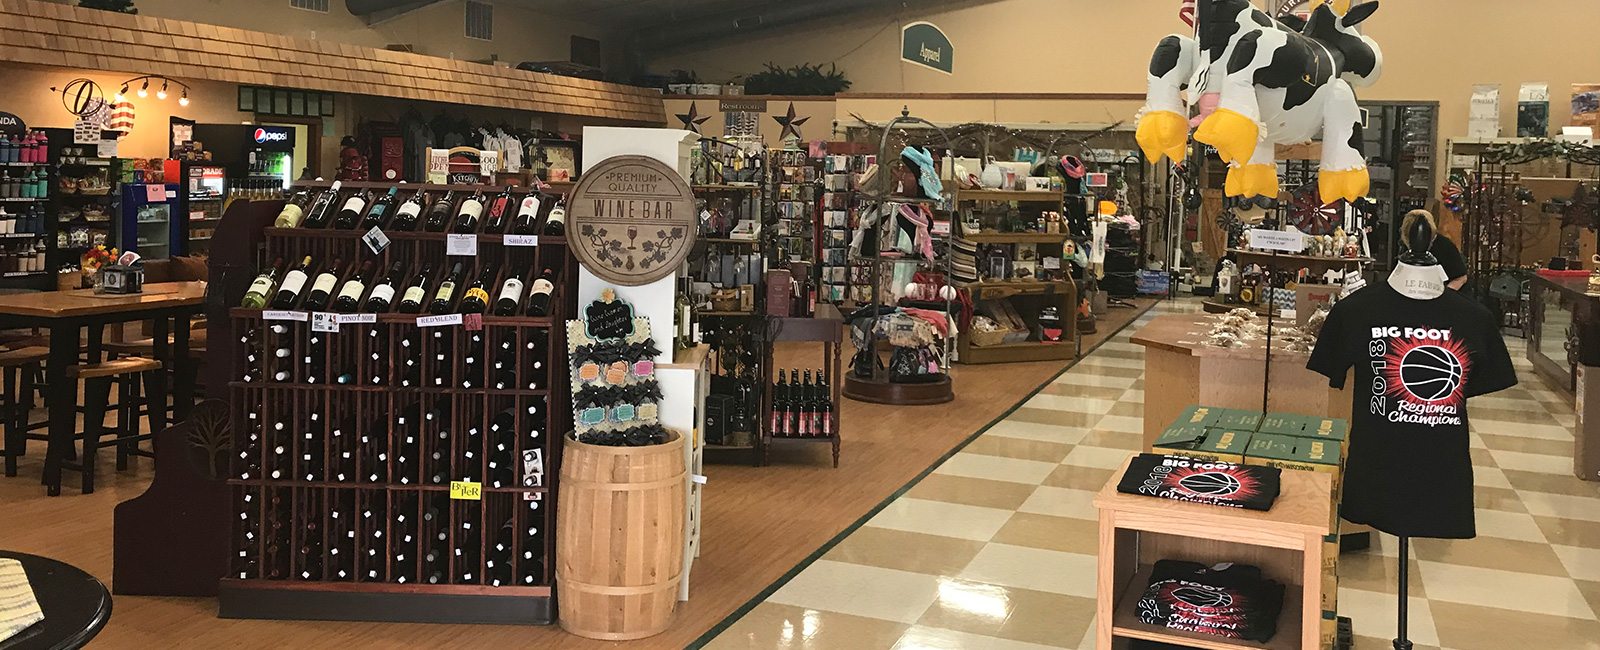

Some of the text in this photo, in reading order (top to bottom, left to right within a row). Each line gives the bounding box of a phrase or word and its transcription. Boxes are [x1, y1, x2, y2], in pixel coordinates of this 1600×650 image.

[920, 42, 940, 62] Apparel
[266, 132, 287, 142] pepsi
[609, 172, 657, 182] PREMIUM
[608, 183, 658, 193] QUALITY
[594, 199, 673, 219] WINE BAR
[314, 313, 324, 321] 90
[1371, 327, 1450, 341] BIG FOOT
[1369, 339, 1387, 416] 2018
[1397, 399, 1457, 415] Regional
[1162, 459, 1190, 468] BIG
[1138, 465, 1173, 495] 2018
